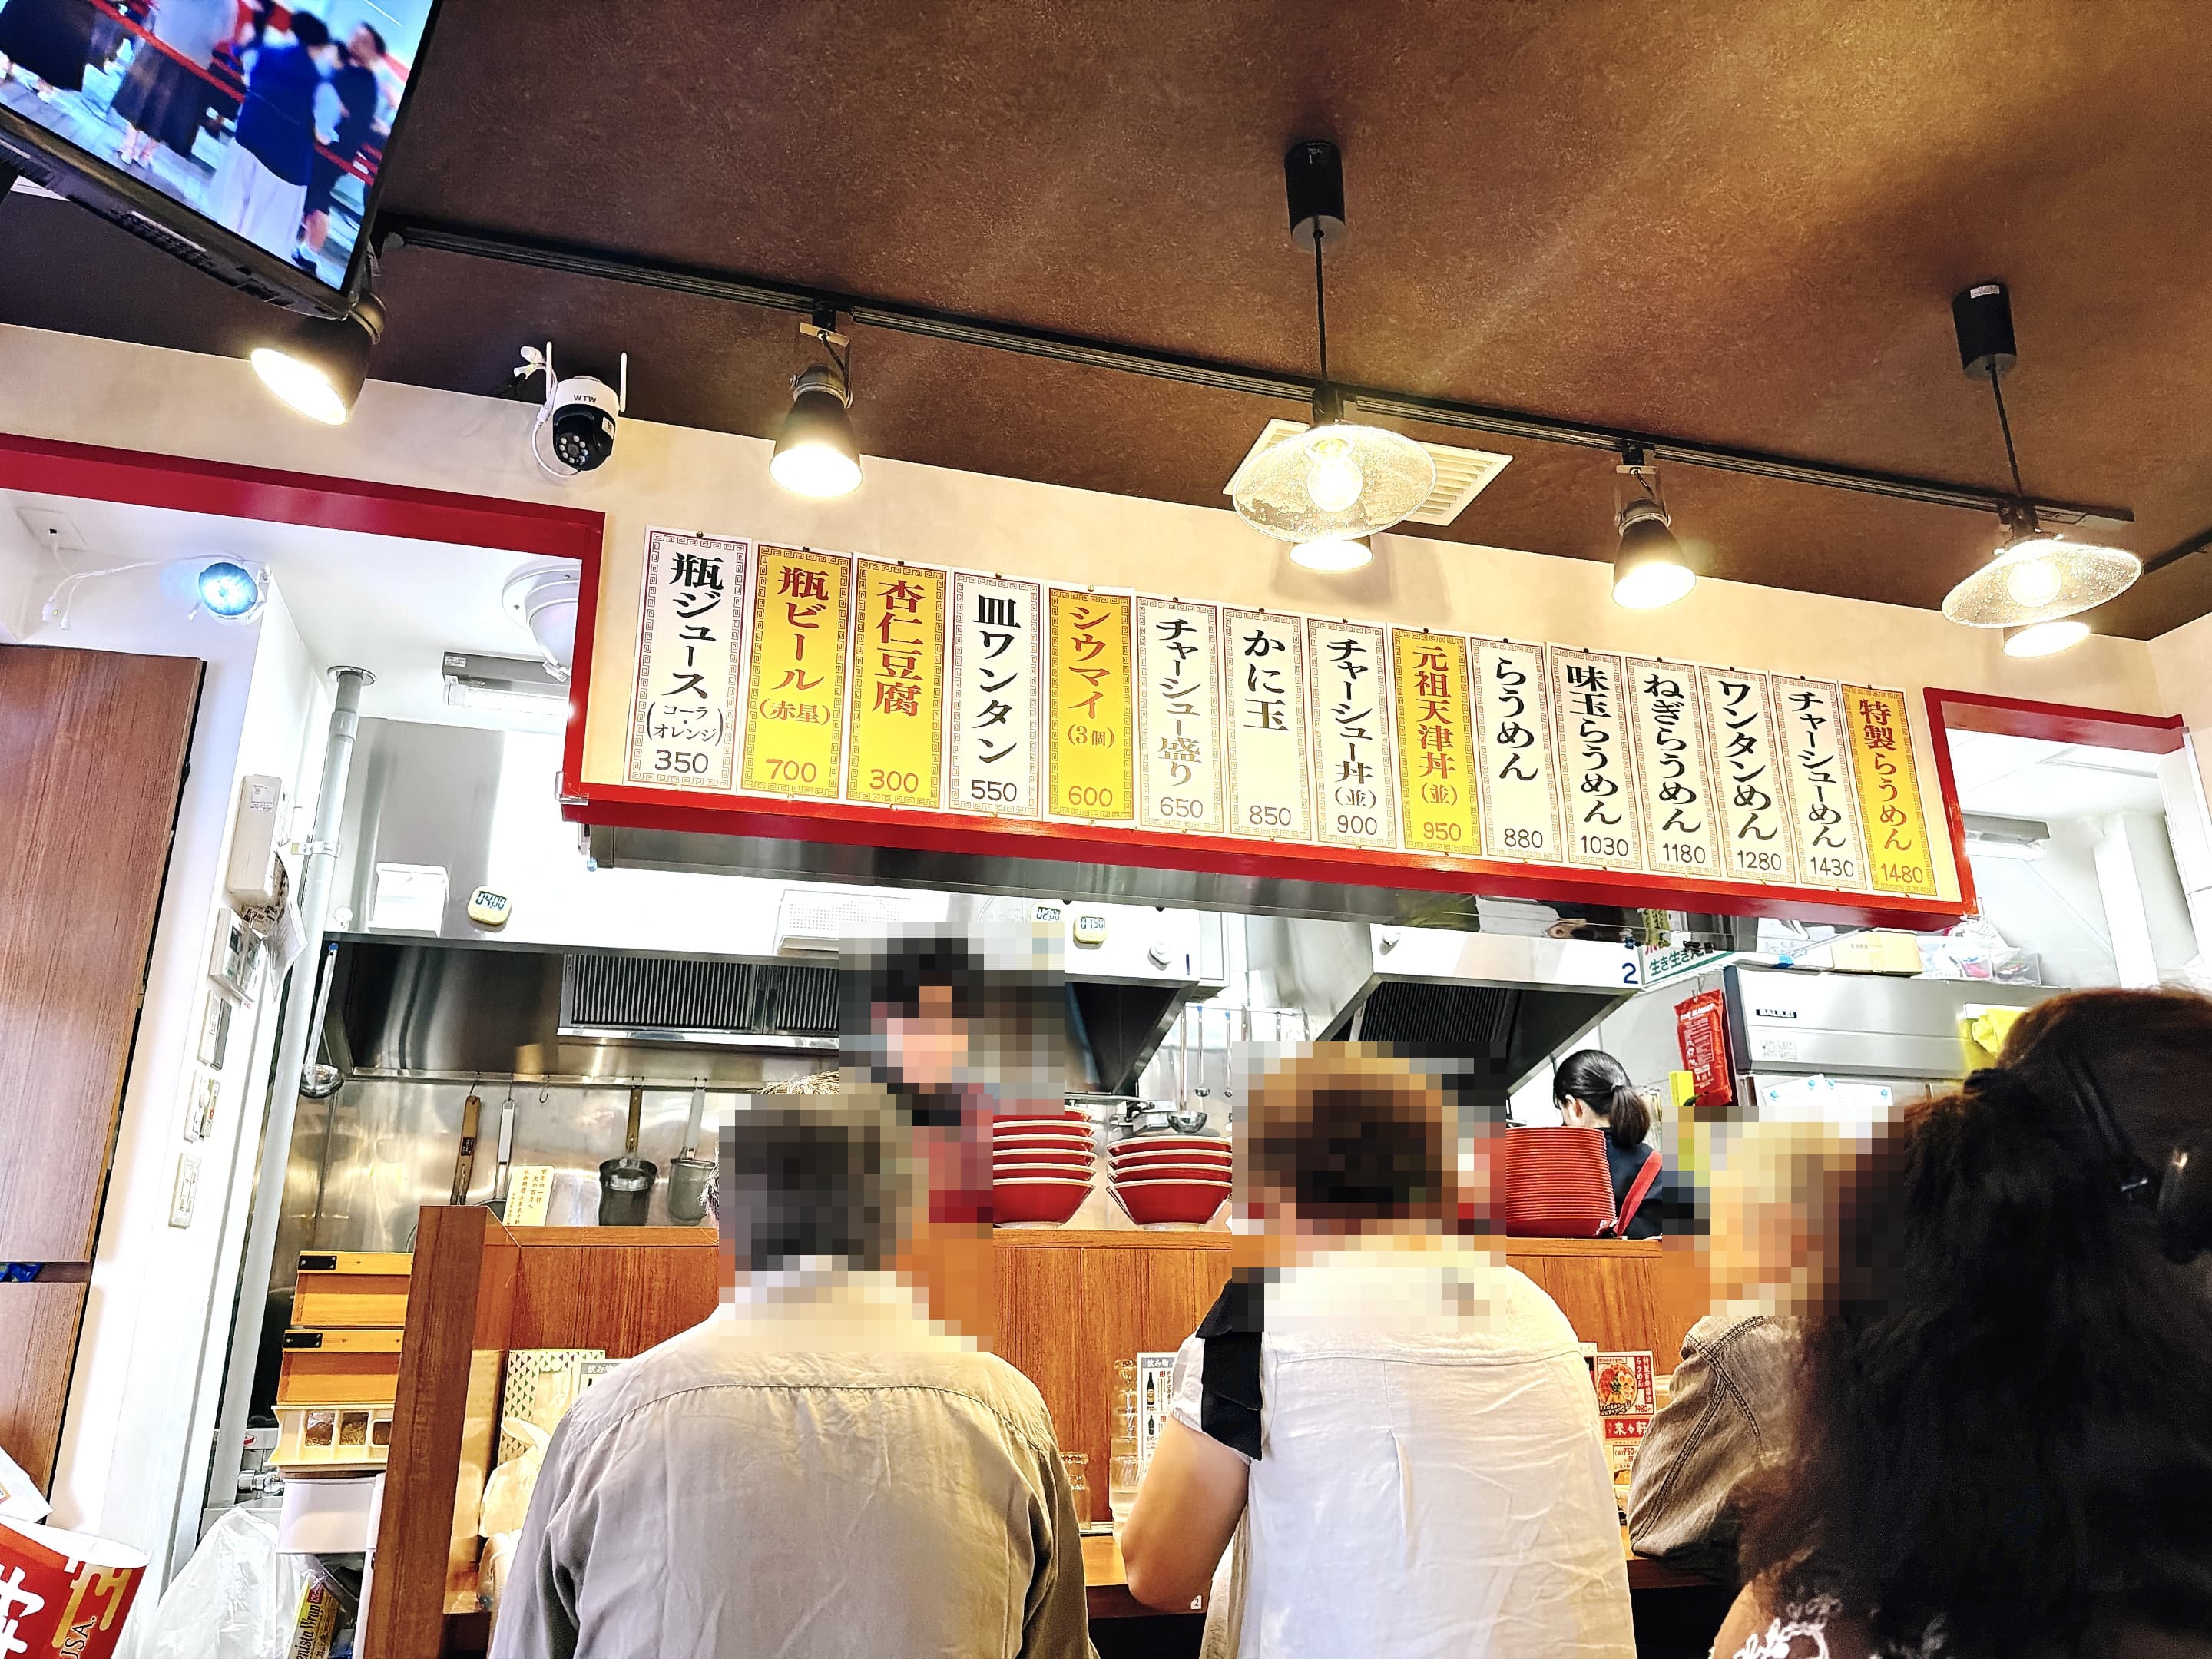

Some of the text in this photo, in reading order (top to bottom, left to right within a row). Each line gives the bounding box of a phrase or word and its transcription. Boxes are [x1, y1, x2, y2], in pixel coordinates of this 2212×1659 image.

[573, 394, 597, 403] WTW
[661, 552, 724, 700] 瓶ジュース
[872, 580, 926, 717] 杏仁豆腐
[972, 594, 1021, 764] 皿ワンタン
[1243, 629, 1289, 731] かに玉
[1156, 618, 1202, 786] チャーシュー盛り
[1495, 657, 1538, 782] らうめん
[1566, 664, 1622, 825] 味玉らうめん
[1643, 673, 1702, 833] ねぎらうめん
[654, 750, 709, 774] 350
[765, 758, 817, 783] 700
[1718, 680, 1777, 841] ワンタンめん
[1788, 691, 1846, 849] チャーシューめん
[869, 769, 919, 793] 300
[1859, 698, 1912, 851] 特製らうめん
[971, 780, 1017, 803] 550
[1068, 786, 1113, 808] 600
[1161, 796, 1204, 819] 650
[1249, 805, 1292, 826] 850
[1336, 814, 1378, 836] 900
[1422, 821, 1462, 842] 950
[1504, 828, 1543, 849] 880
[1580, 835, 1628, 857] 1030
[1662, 843, 1706, 864] 1180
[1737, 850, 1782, 871] 1280
[1810, 856, 1854, 877] 1430
[1880, 863, 1923, 884] 1480
[1622, 962, 1638, 984] 2
[300, 1604, 324, 1629] Wrap
